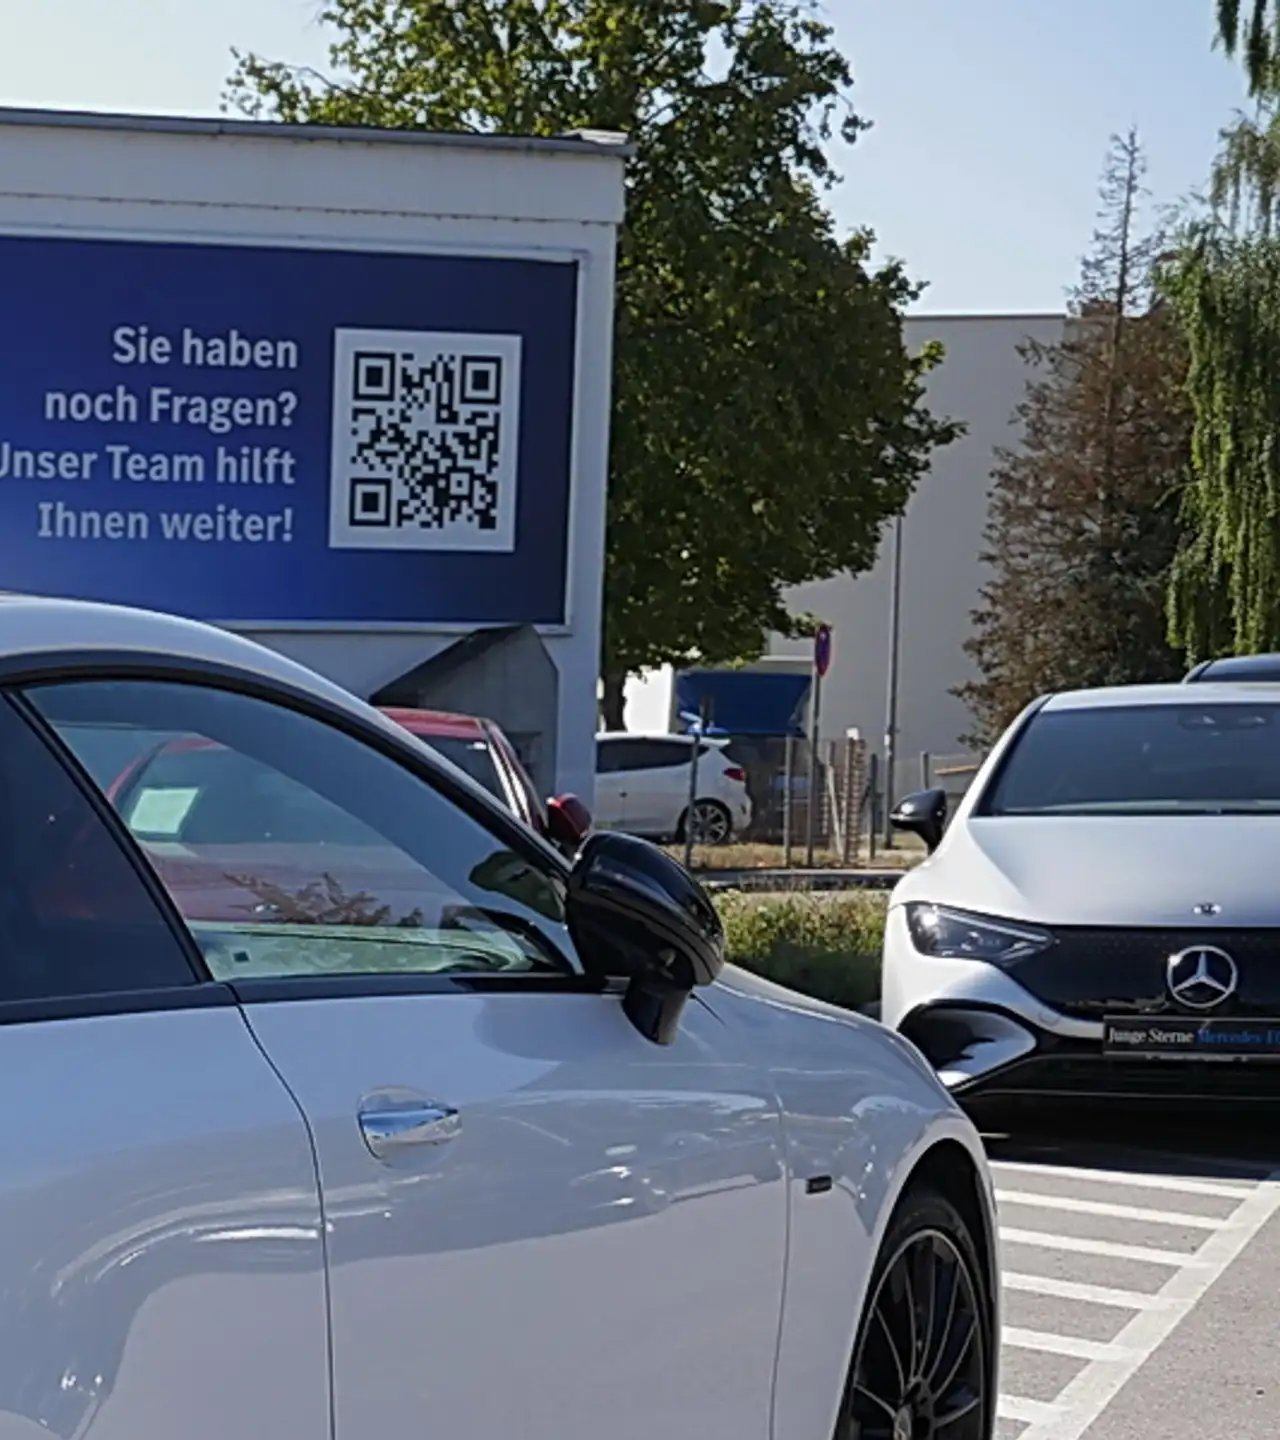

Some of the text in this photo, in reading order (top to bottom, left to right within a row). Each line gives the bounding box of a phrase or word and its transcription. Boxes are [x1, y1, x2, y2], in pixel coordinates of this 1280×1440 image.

[113, 325, 297, 368] Sie haben
[45, 385, 297, 433] noch Fragen?
[106, 445, 204, 482] Team
[216, 446, 295, 484] hilft
[38, 502, 293, 542] Ihnen weiter!
